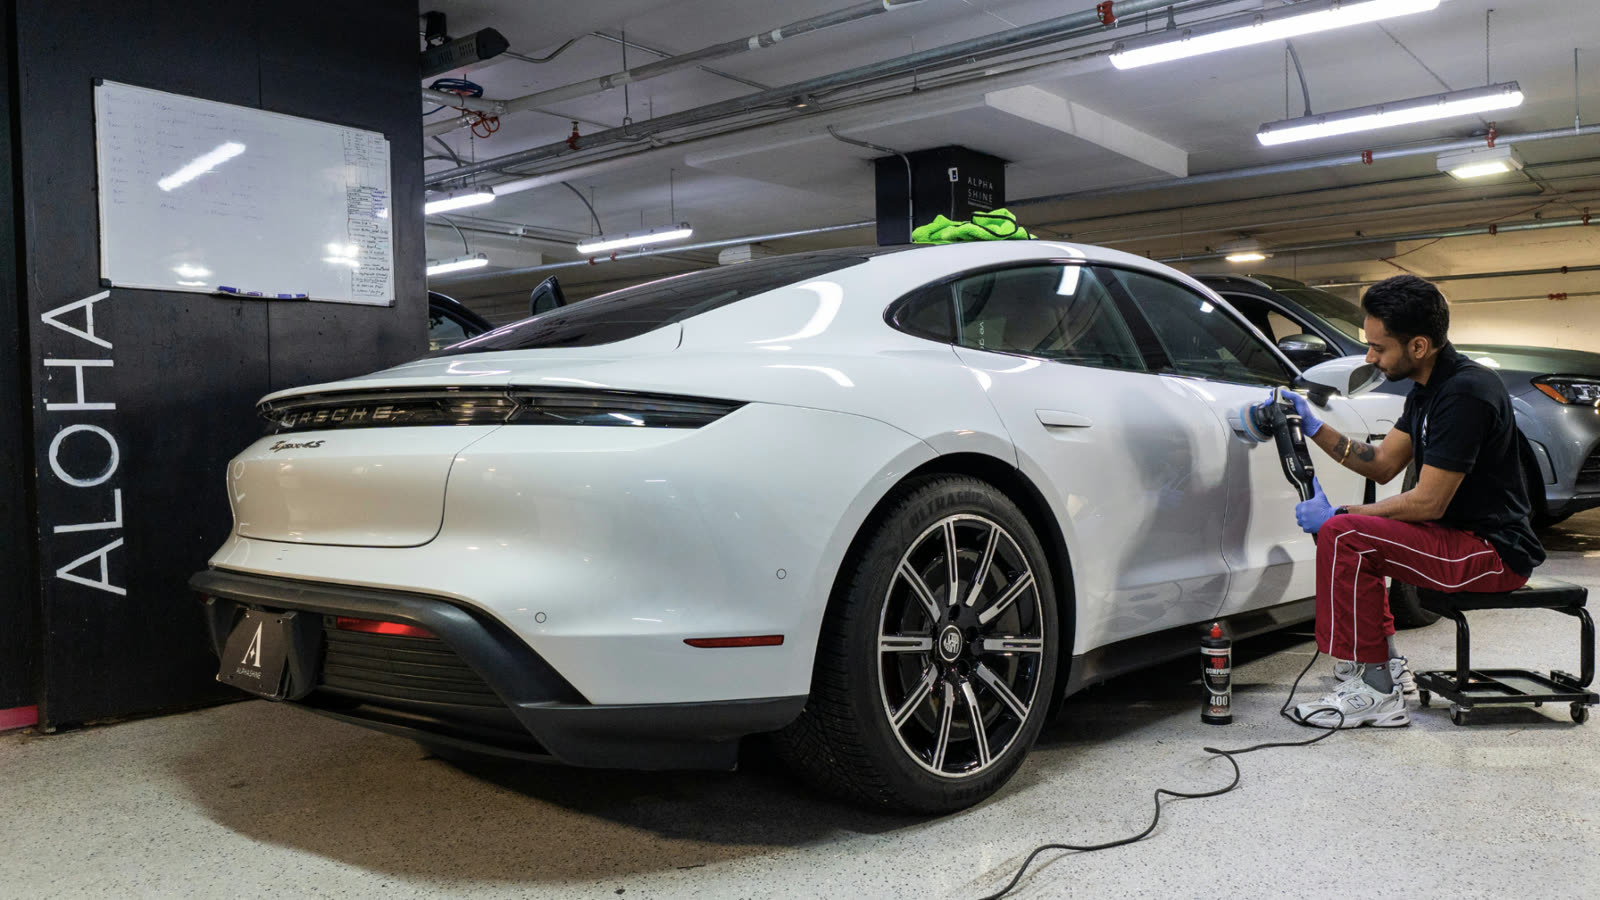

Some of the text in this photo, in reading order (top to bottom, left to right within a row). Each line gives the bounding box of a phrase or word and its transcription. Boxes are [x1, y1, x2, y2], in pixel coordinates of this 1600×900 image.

[967, 176, 993, 191] ALPHA
[967, 188, 993, 202] SHINE
[41, 290, 127, 597] ALOHA
[1209, 695, 1228, 706] 400
